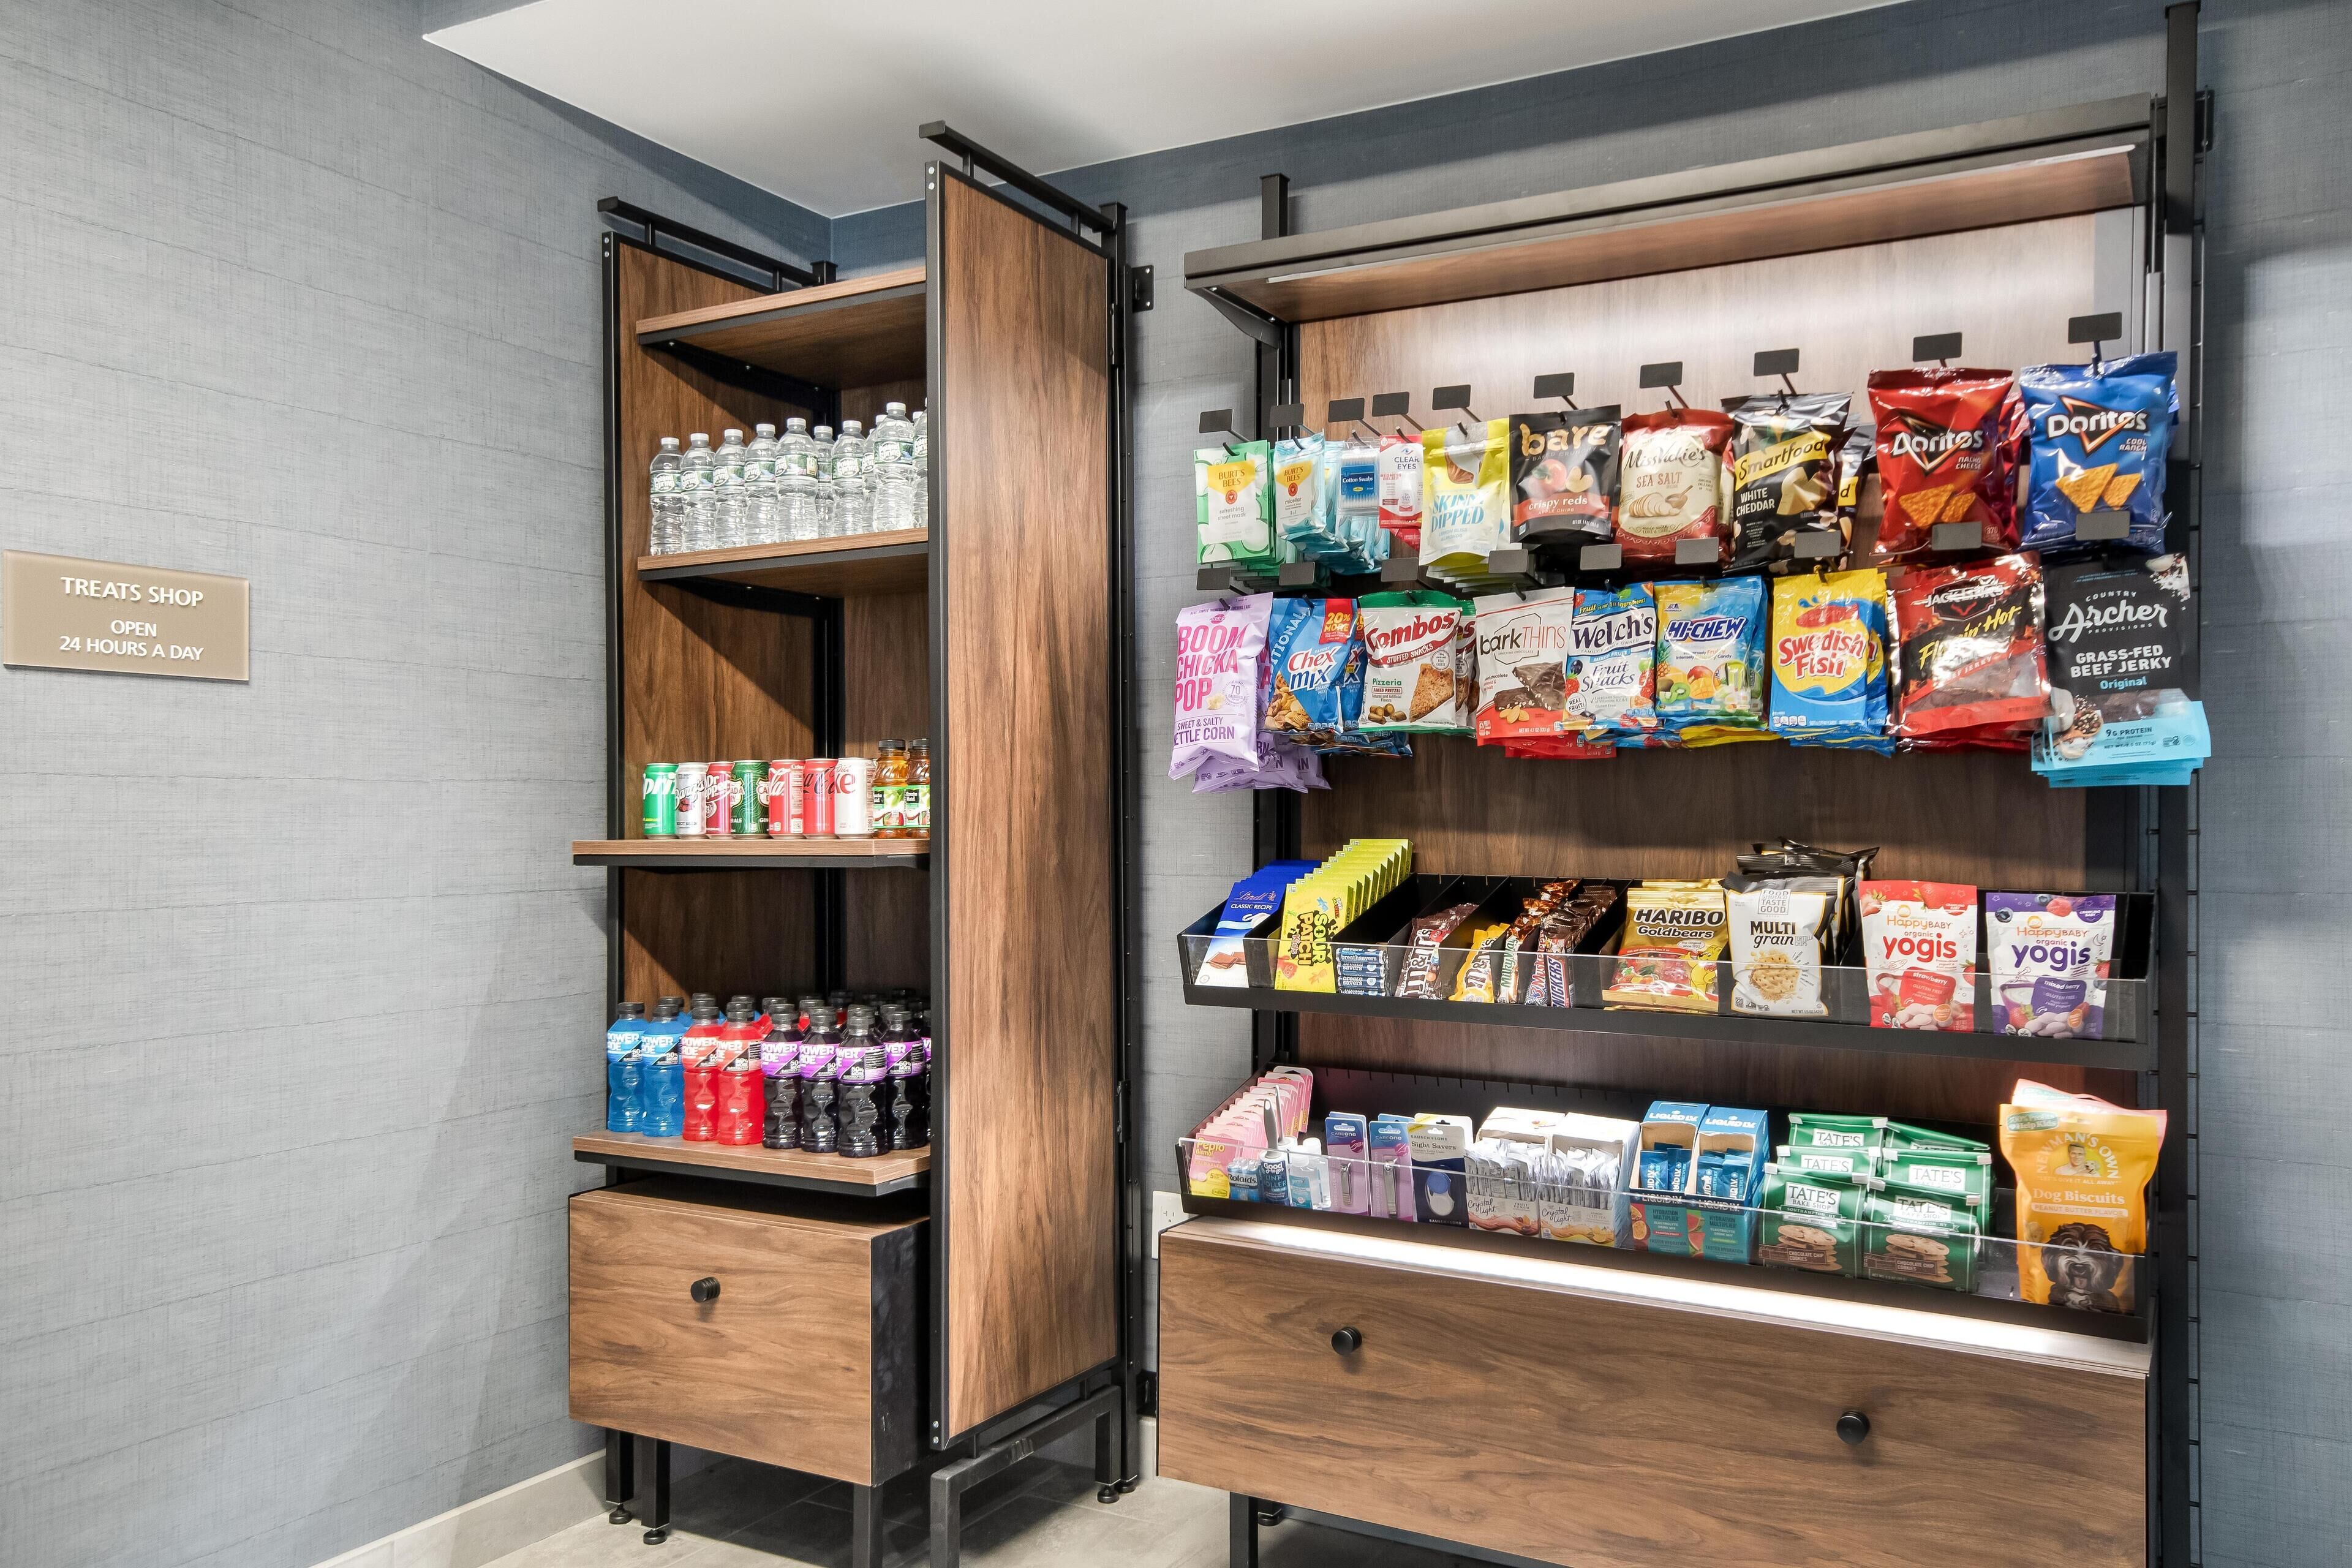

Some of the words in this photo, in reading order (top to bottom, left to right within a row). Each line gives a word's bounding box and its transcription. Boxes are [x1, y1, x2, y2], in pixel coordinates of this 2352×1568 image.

[2048, 412, 2148, 439] Doritos
[1520, 423, 1613, 456] bare
[1891, 429, 1983, 458] Doritos
[1739, 439, 1824, 481] Smartfood
[1218, 469, 1245, 480] BURT'S
[1284, 467, 1303, 476] BURT'S
[1223, 478, 1241, 487] BEES
[1637, 475, 1653, 488] SEA
[1657, 472, 1683, 484] SALT
[1529, 499, 1559, 511] crispy
[1562, 495, 1588, 505] reds
[1741, 487, 1768, 503] WHITE
[1736, 499, 1775, 517] CHEDDAR
[1431, 506, 1485, 533] DIPPED
[60, 577, 141, 601] TREATS
[148, 586, 204, 606] SHOP
[2086, 590, 2137, 602] COUNTRY
[1328, 612, 1350, 624] 20%
[2048, 600, 2168, 643] Archer
[110, 620, 157, 637] OPEN
[1324, 624, 1349, 633] MORE
[1366, 612, 1457, 651] Combos
[1572, 613, 1654, 649] Welch's
[1665, 617, 1748, 641] HI-CHEW
[2087, 623, 2153, 634] PROVISIONS
[59, 635, 81, 651] 24
[86, 638, 147, 657] HOURS
[152, 644, 165, 658] A
[170, 644, 205, 661] DAY
[1178, 624, 1250, 656] BOOM
[1779, 629, 1866, 665] Swedish
[1289, 647, 1338, 671] Chex
[1387, 653, 1409, 663] STUFFED
[1411, 643, 1433, 658] SNACKS
[2076, 644, 2163, 664] GRASS-FED
[1176, 649, 1238, 682] CHICKA
[1593, 662, 1629, 676] Fruit
[1795, 652, 1846, 677] Fish
[2070, 663, 2113, 678] BEEF
[2118, 657, 2172, 673] JERKY
[1231, 685, 1240, 695] 70
[2100, 676, 2147, 691] Original
[1175, 677, 1212, 716] POP
[1177, 720, 1194, 731] SWEET
[1203, 717, 1223, 726] SALTY
[2120, 727, 2152, 736] PROTEIN
[1204, 726, 1235, 740] CORN
[706, 775, 719, 785] Dr
[1634, 908, 1725, 926] HARIBO
[1637, 925, 1715, 939] Goldbears
[1750, 921, 1796, 935] MULTI
[1297, 911, 1313, 966] PATCH
[1312, 913, 1328, 963] SOUR
[1754, 935, 1794, 948] grain
[1883, 933, 1957, 963] yogis
[2011, 941, 2091, 971] yogis
[1912, 971, 1948, 985] strawberry
[2044, 980, 2064, 990] mixed
[608, 1033, 639, 1044] POWER
[762, 1043, 797, 1053] POWER
[801, 1045, 834, 1055] POWER
[1705, 1118, 1741, 1127] LIQUID
[1411, 1140, 1430, 1149] Sight
[1817, 1132, 1861, 1146] TATE'S
[2037, 1132, 2099, 1174] NEWMAN'S
[2098, 1146, 2121, 1178] OWN
[1803, 1158, 1850, 1172] TATE'S
[1228, 1174, 1256, 1183] Rolaids
[1912, 1167, 1962, 1183] TATE'S
[1789, 1186, 1837, 1205] TATE'S
[2033, 1188, 2061, 1202] Dog
[2065, 1191, 2125, 1205] Biscuits
[1468, 1197, 1493, 1212] Crystal
[1898, 1198, 1948, 1215] TATE'S
[1542, 1207, 1569, 1221] Crystal
